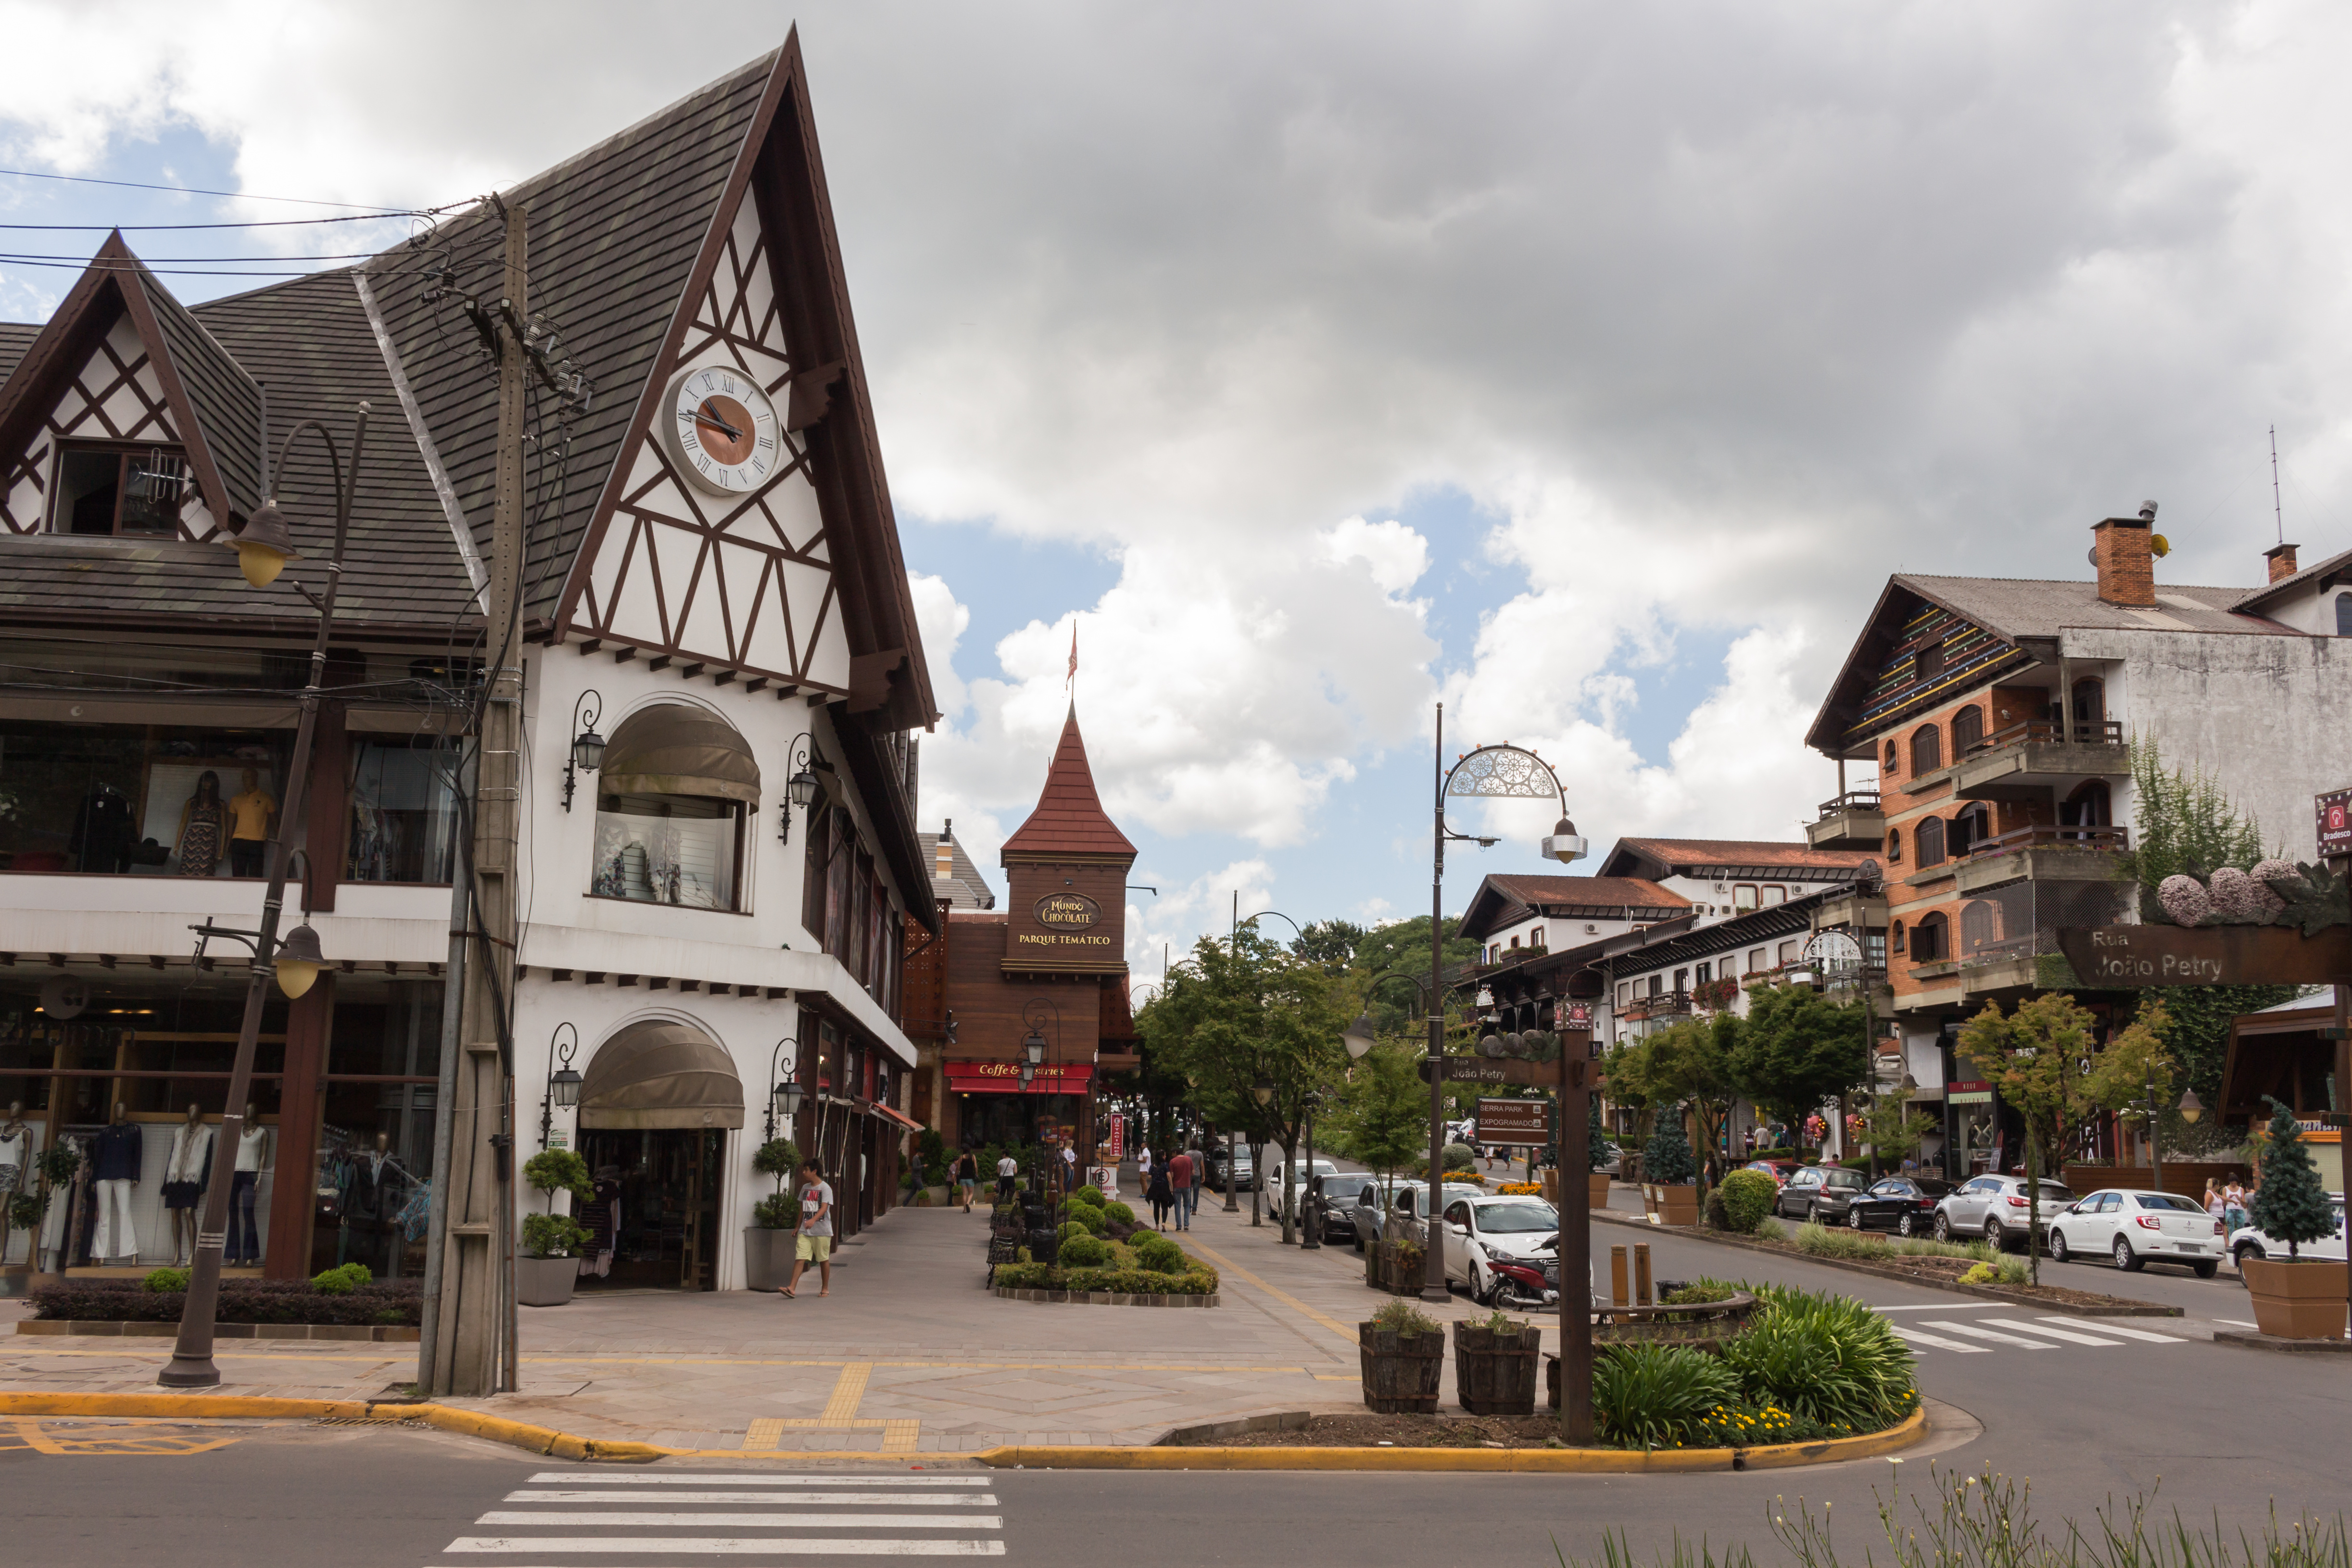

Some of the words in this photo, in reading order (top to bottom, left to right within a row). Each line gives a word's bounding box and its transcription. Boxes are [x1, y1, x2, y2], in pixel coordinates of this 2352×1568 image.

[701, 373, 715, 392] XI
[722, 374, 734, 394] XII
[685, 385, 699, 402] X
[744, 391, 753, 403] I
[756, 413, 770, 423] II
[682, 430, 698, 450] VIII
[759, 436, 773, 450] III
[697, 453, 711, 474] VII
[751, 455, 765, 474] IV
[719, 468, 728, 486] VI
[738, 468, 747, 485] V
[2324, 831, 2351, 840] Bradesco
[1051, 901, 1083, 912] MUNDO
[1042, 908, 1092, 923] CHOCOLATE
[1019, 935, 1056, 945] PARQUE
[1059, 934, 1110, 945] TEMÁTICO
[2093, 932, 2128, 946] Rua
[2096, 954, 2153, 976] João
[2162, 954, 2222, 982] Petry
[979, 1064, 1009, 1076] Coffe
[1010, 1066, 1020, 1075] &
[1035, 1067, 1064, 1075] stries
[1453, 1069, 1477, 1078] João
[1480, 1069, 1505, 1081] Petry
